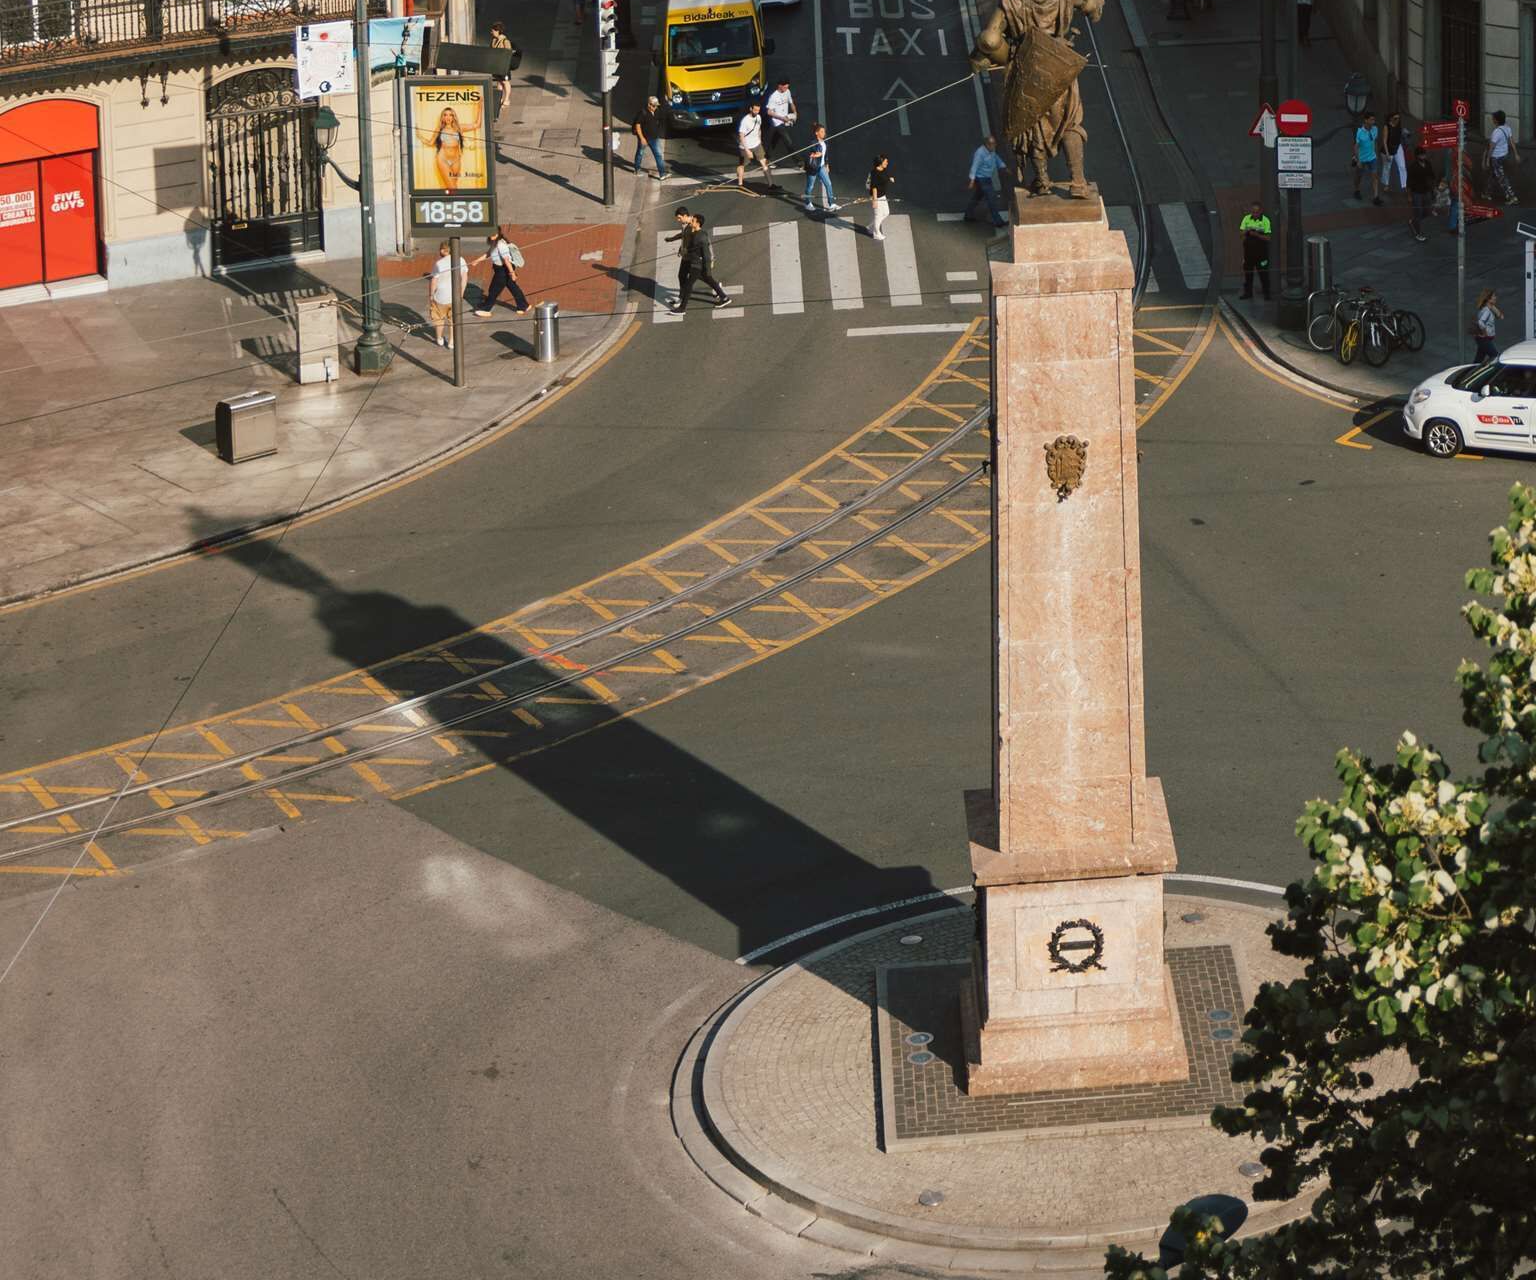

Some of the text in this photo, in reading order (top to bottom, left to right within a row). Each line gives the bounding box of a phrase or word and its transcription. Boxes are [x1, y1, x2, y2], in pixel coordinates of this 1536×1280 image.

[836, 26, 949, 56] TAXI
[51, 198, 85, 213] GUYS
[53, 190, 82, 203] FIVE
[420, 201, 484, 224] 18:58
